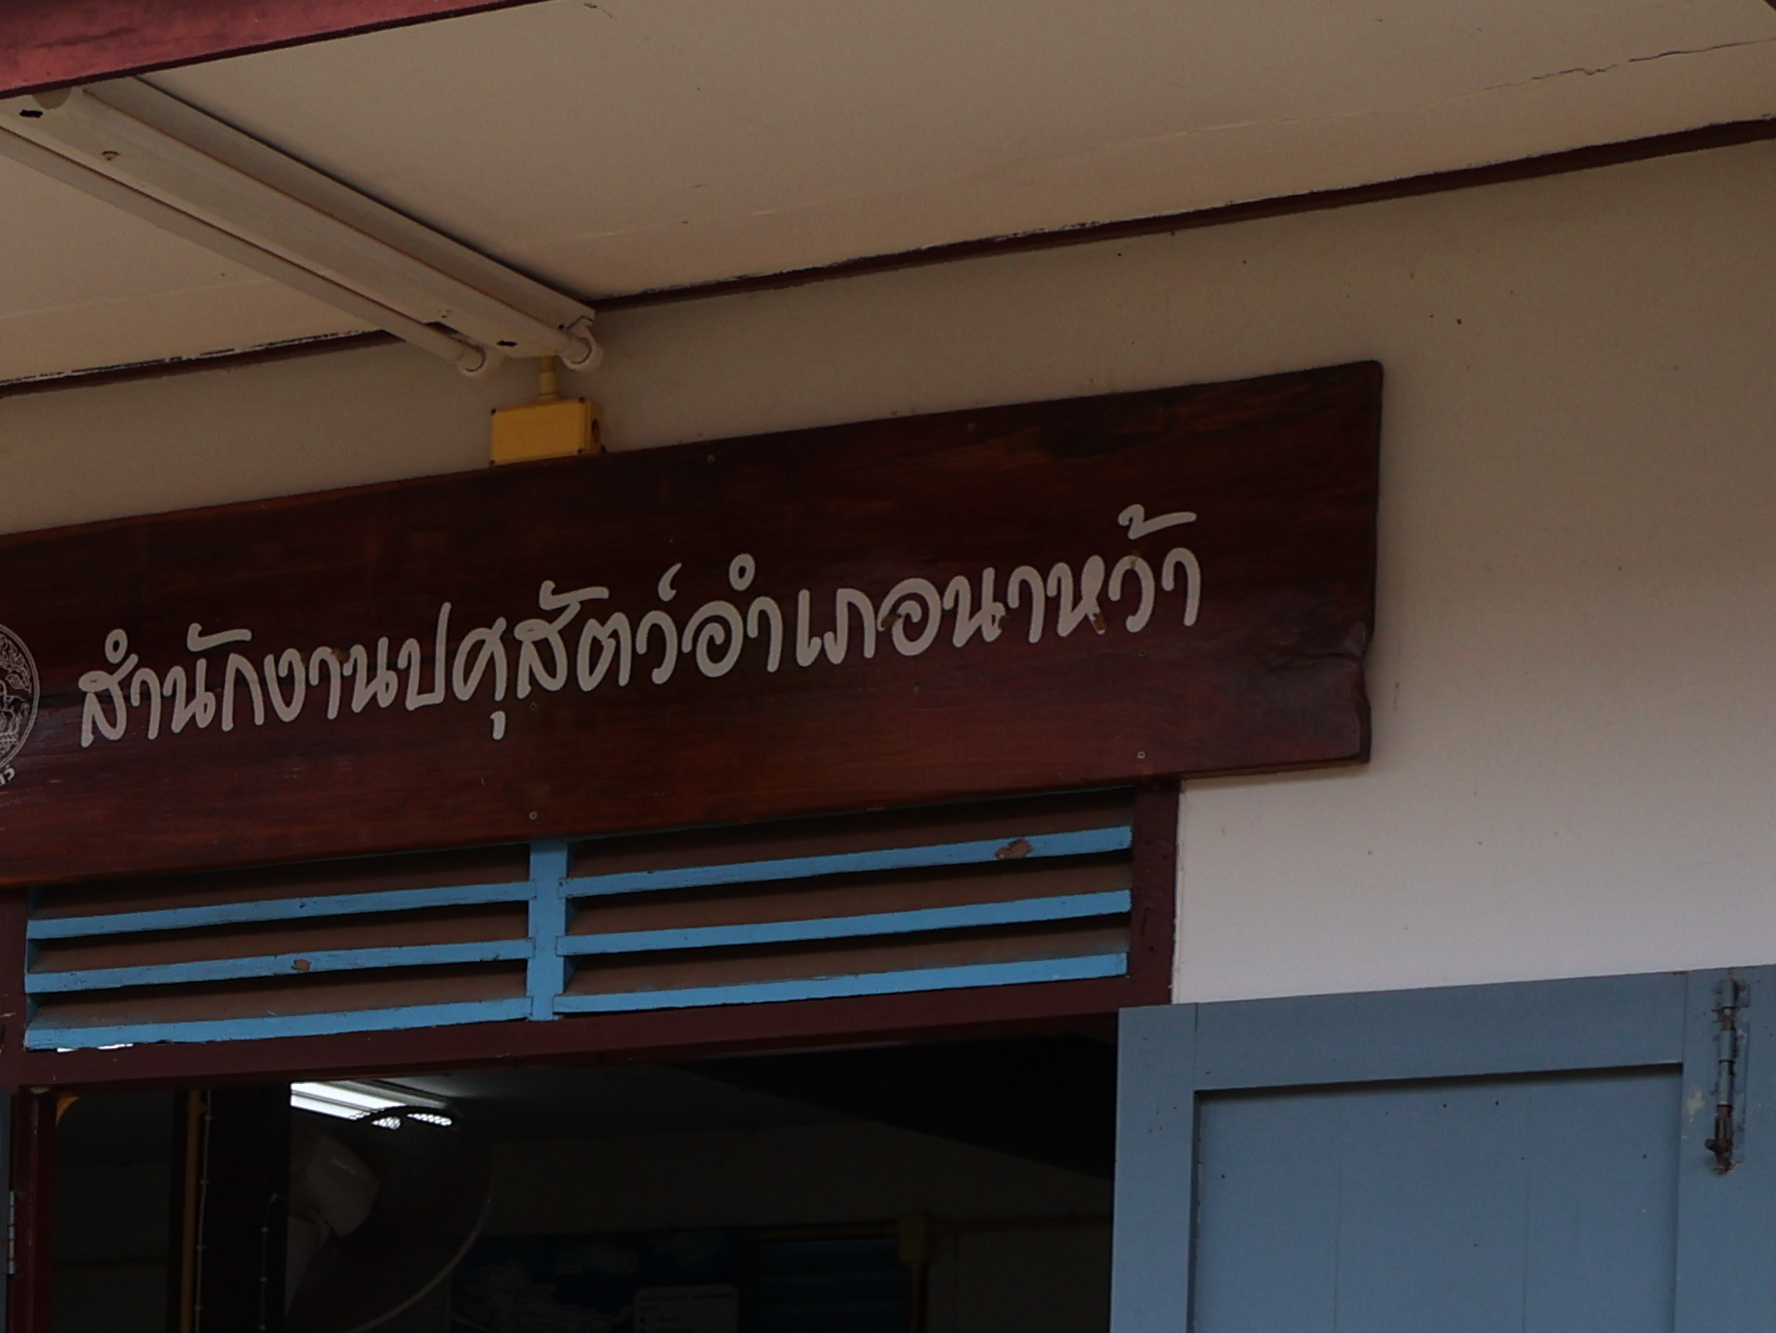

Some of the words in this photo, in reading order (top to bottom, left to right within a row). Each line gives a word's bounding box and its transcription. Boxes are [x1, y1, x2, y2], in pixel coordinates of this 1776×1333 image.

[77, 502, 1203, 749] สำนักงานปศุสัตว์อำเภอนาหว้า
